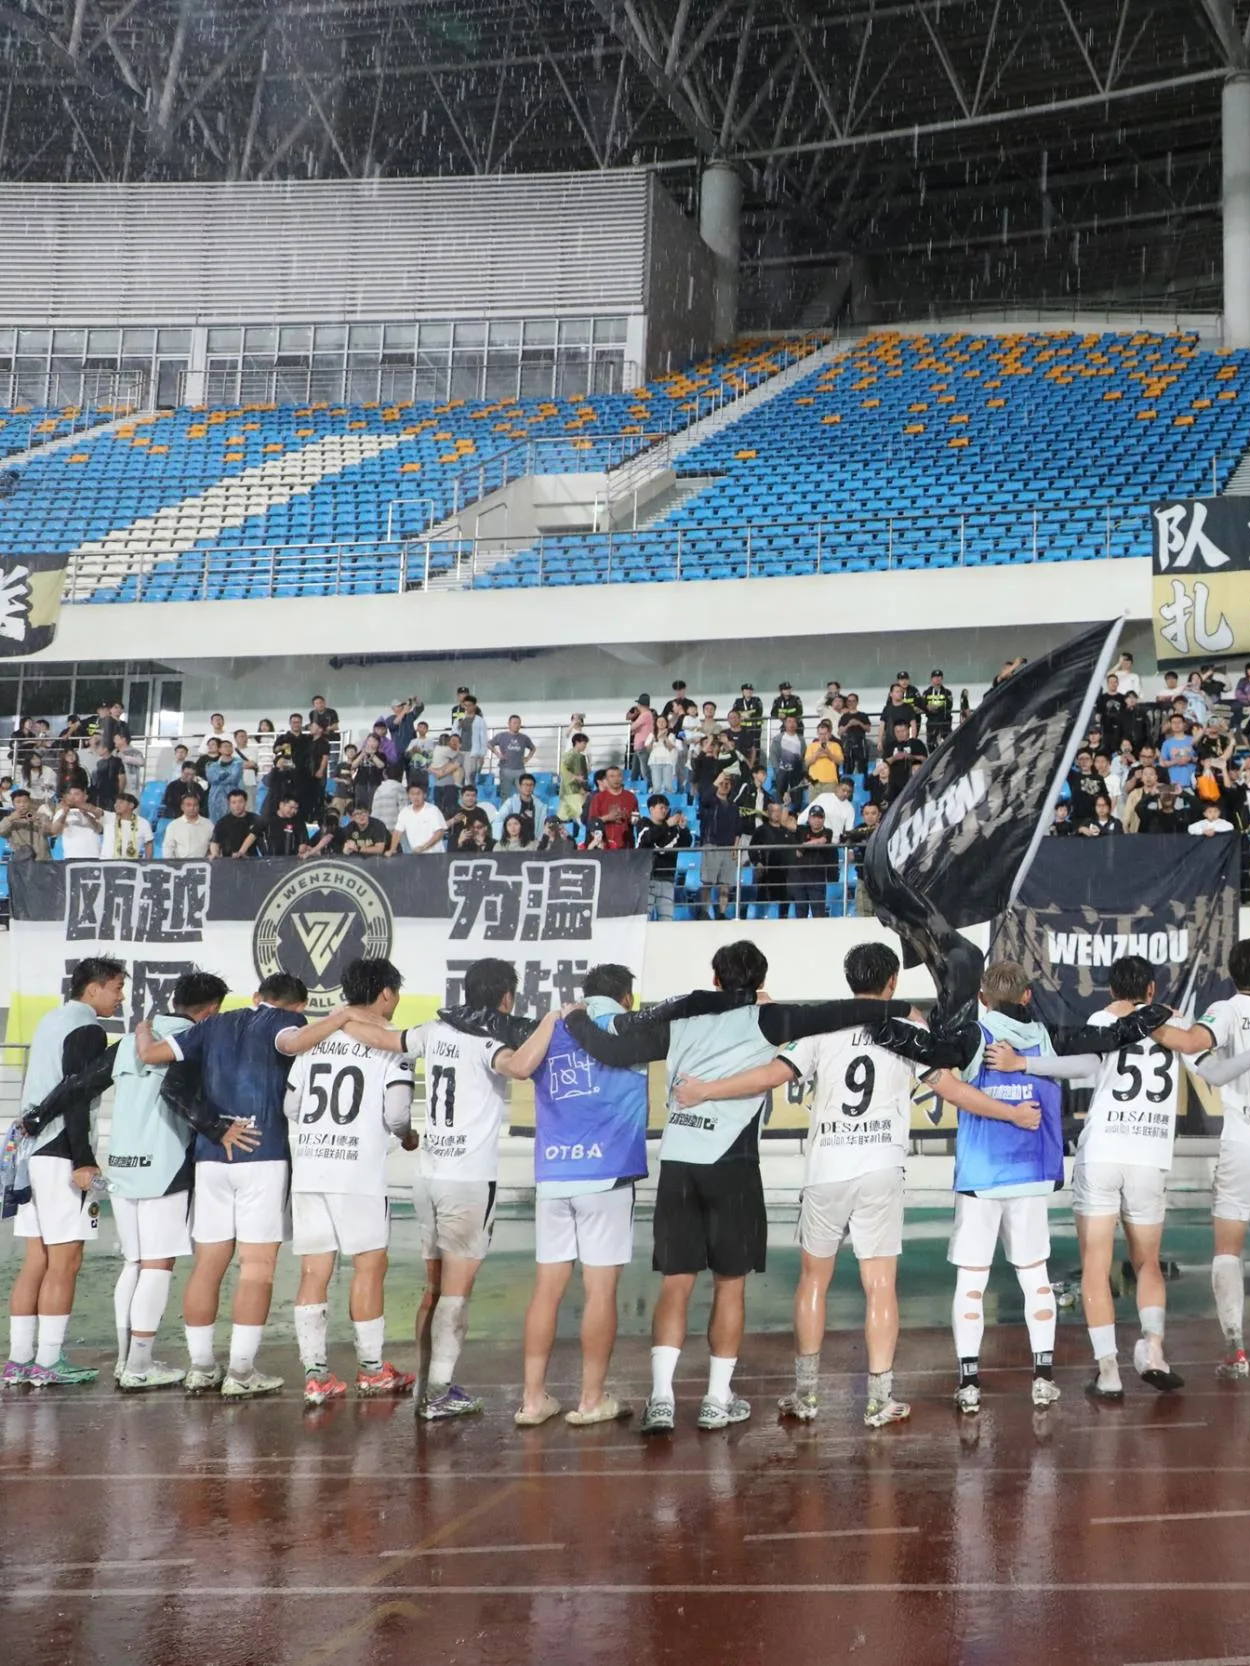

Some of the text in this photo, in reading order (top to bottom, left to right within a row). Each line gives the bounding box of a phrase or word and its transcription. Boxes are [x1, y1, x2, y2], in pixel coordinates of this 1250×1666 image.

[283, 872, 367, 900] WENZHOU
[1048, 929, 1189, 967] WENZHOU
[302, 1063, 365, 1125] 50
[430, 1064, 457, 1128] 11
[841, 1055, 876, 1117] 9
[1112, 1044, 1174, 1102] 53
